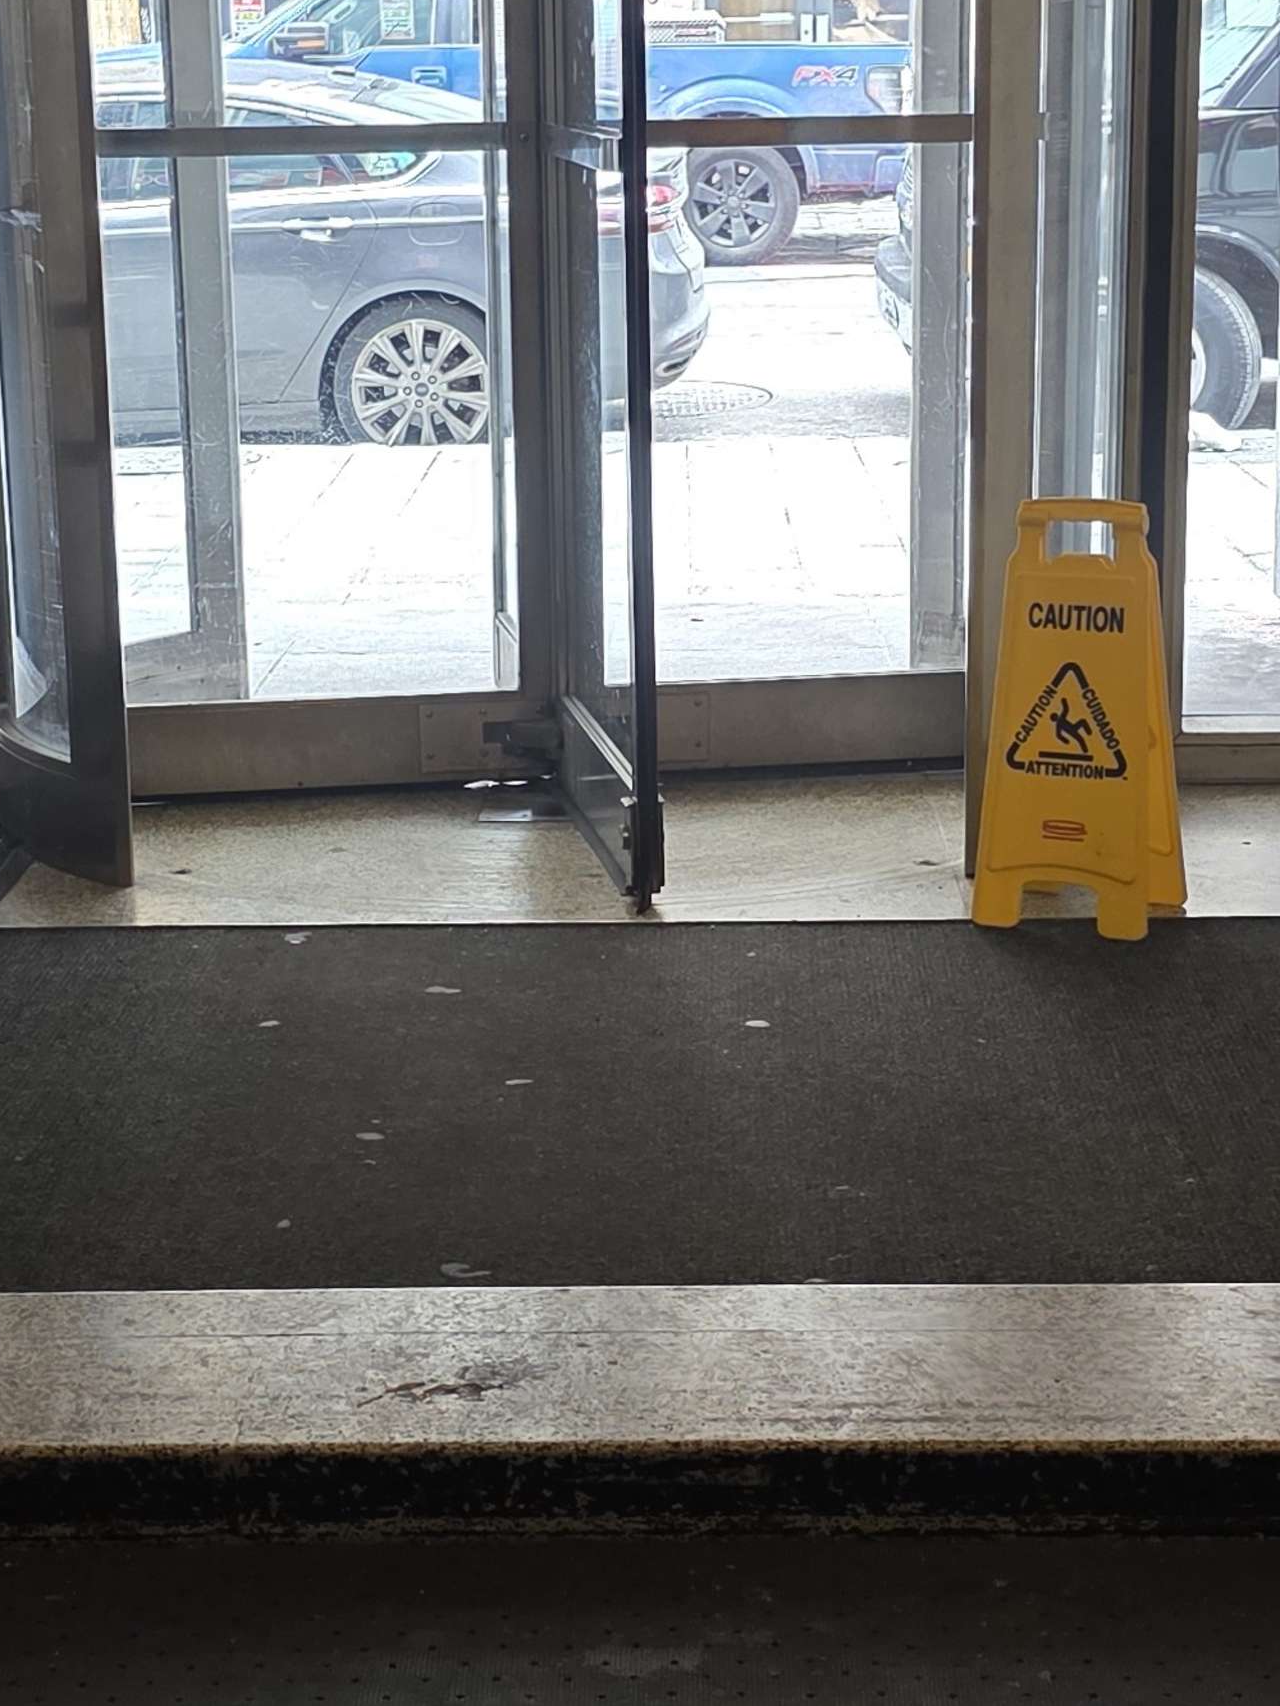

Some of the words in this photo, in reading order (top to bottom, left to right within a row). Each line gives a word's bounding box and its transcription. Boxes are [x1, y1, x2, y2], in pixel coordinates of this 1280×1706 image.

[1028, 602, 1125, 633] CAUTION
[1015, 684, 1058, 743] CAUTION
[1081, 688, 1120, 750] CUIDADO
[1025, 760, 1105, 780] ATTENTION
